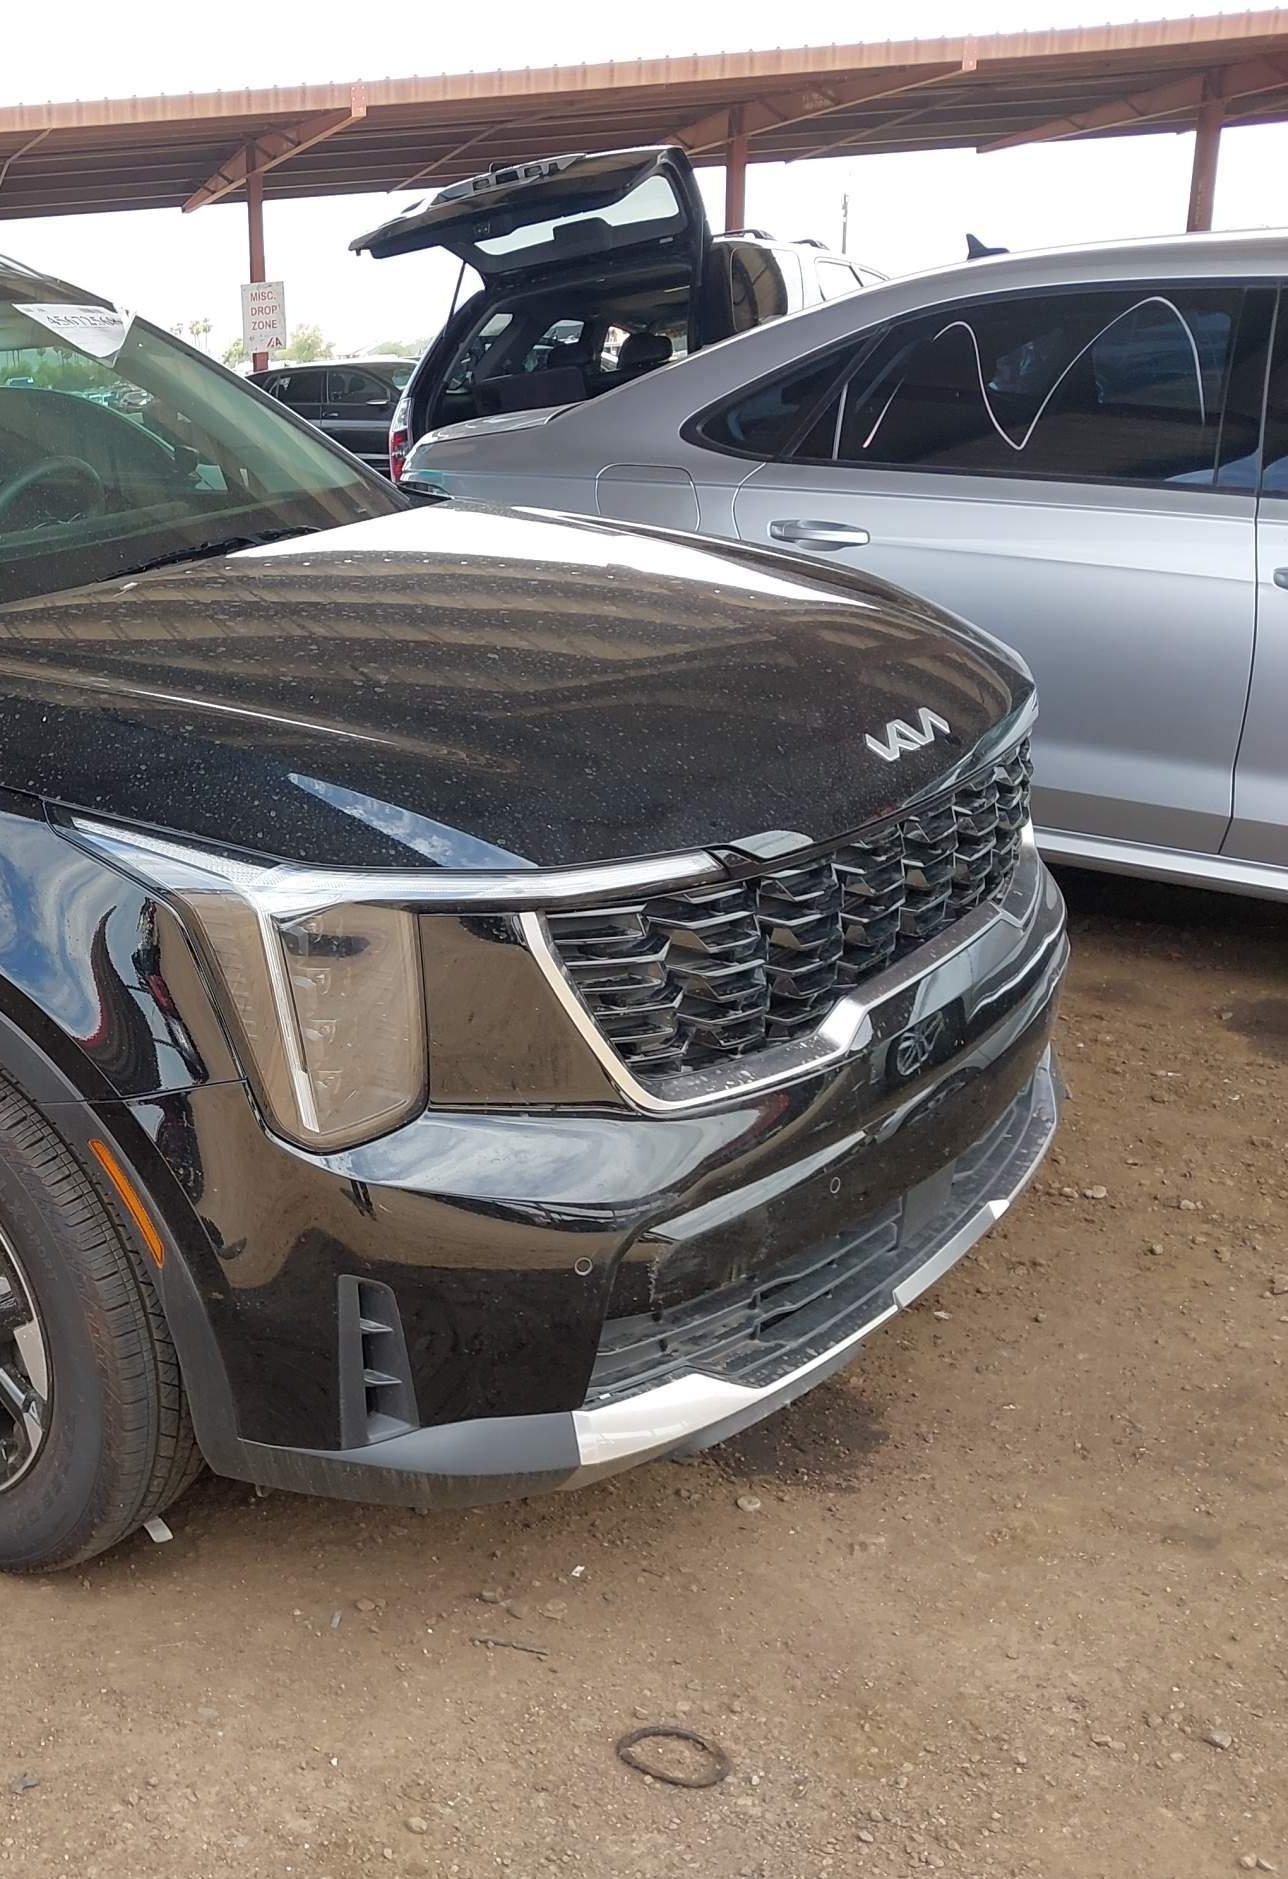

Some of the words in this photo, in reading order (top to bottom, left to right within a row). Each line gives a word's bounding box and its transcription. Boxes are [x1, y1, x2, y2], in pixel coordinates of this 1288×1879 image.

[250, 290, 277, 303] MISC.
[250, 304, 278, 317] DROP
[251, 319, 278, 331] ZONE
[864, 706, 951, 762] KIA
